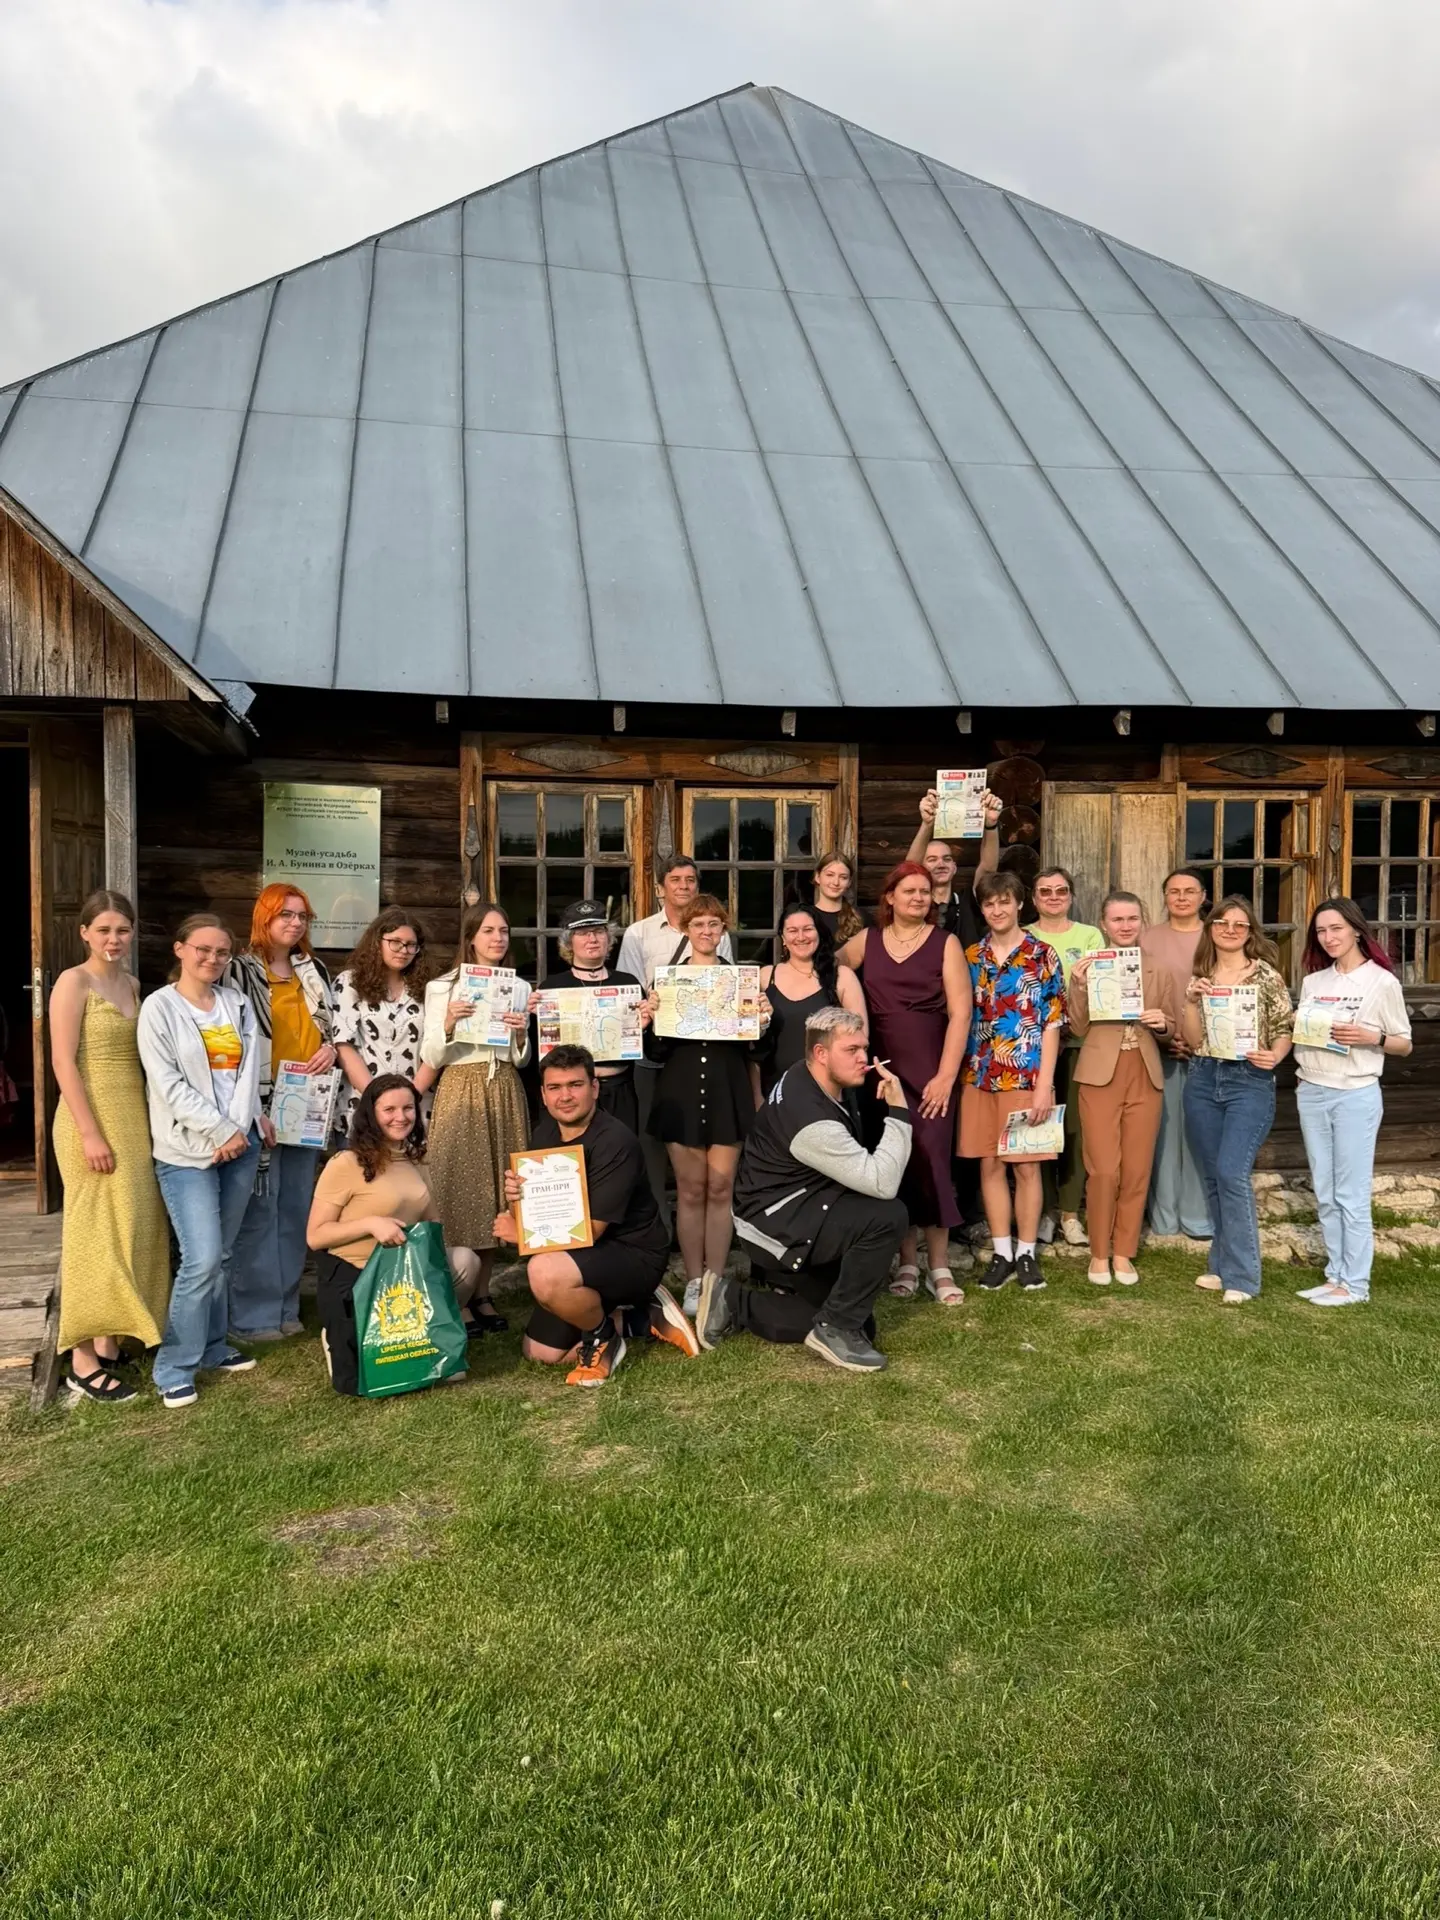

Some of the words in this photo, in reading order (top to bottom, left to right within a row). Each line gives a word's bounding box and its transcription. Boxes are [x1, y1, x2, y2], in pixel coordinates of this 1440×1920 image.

[285, 848, 357, 859] Музей-усадьба
[290, 860, 326, 869] Бунина
[336, 861, 376, 871] Озёрках
[531, 1183, 570, 1194] ГРАН-ПРИ
